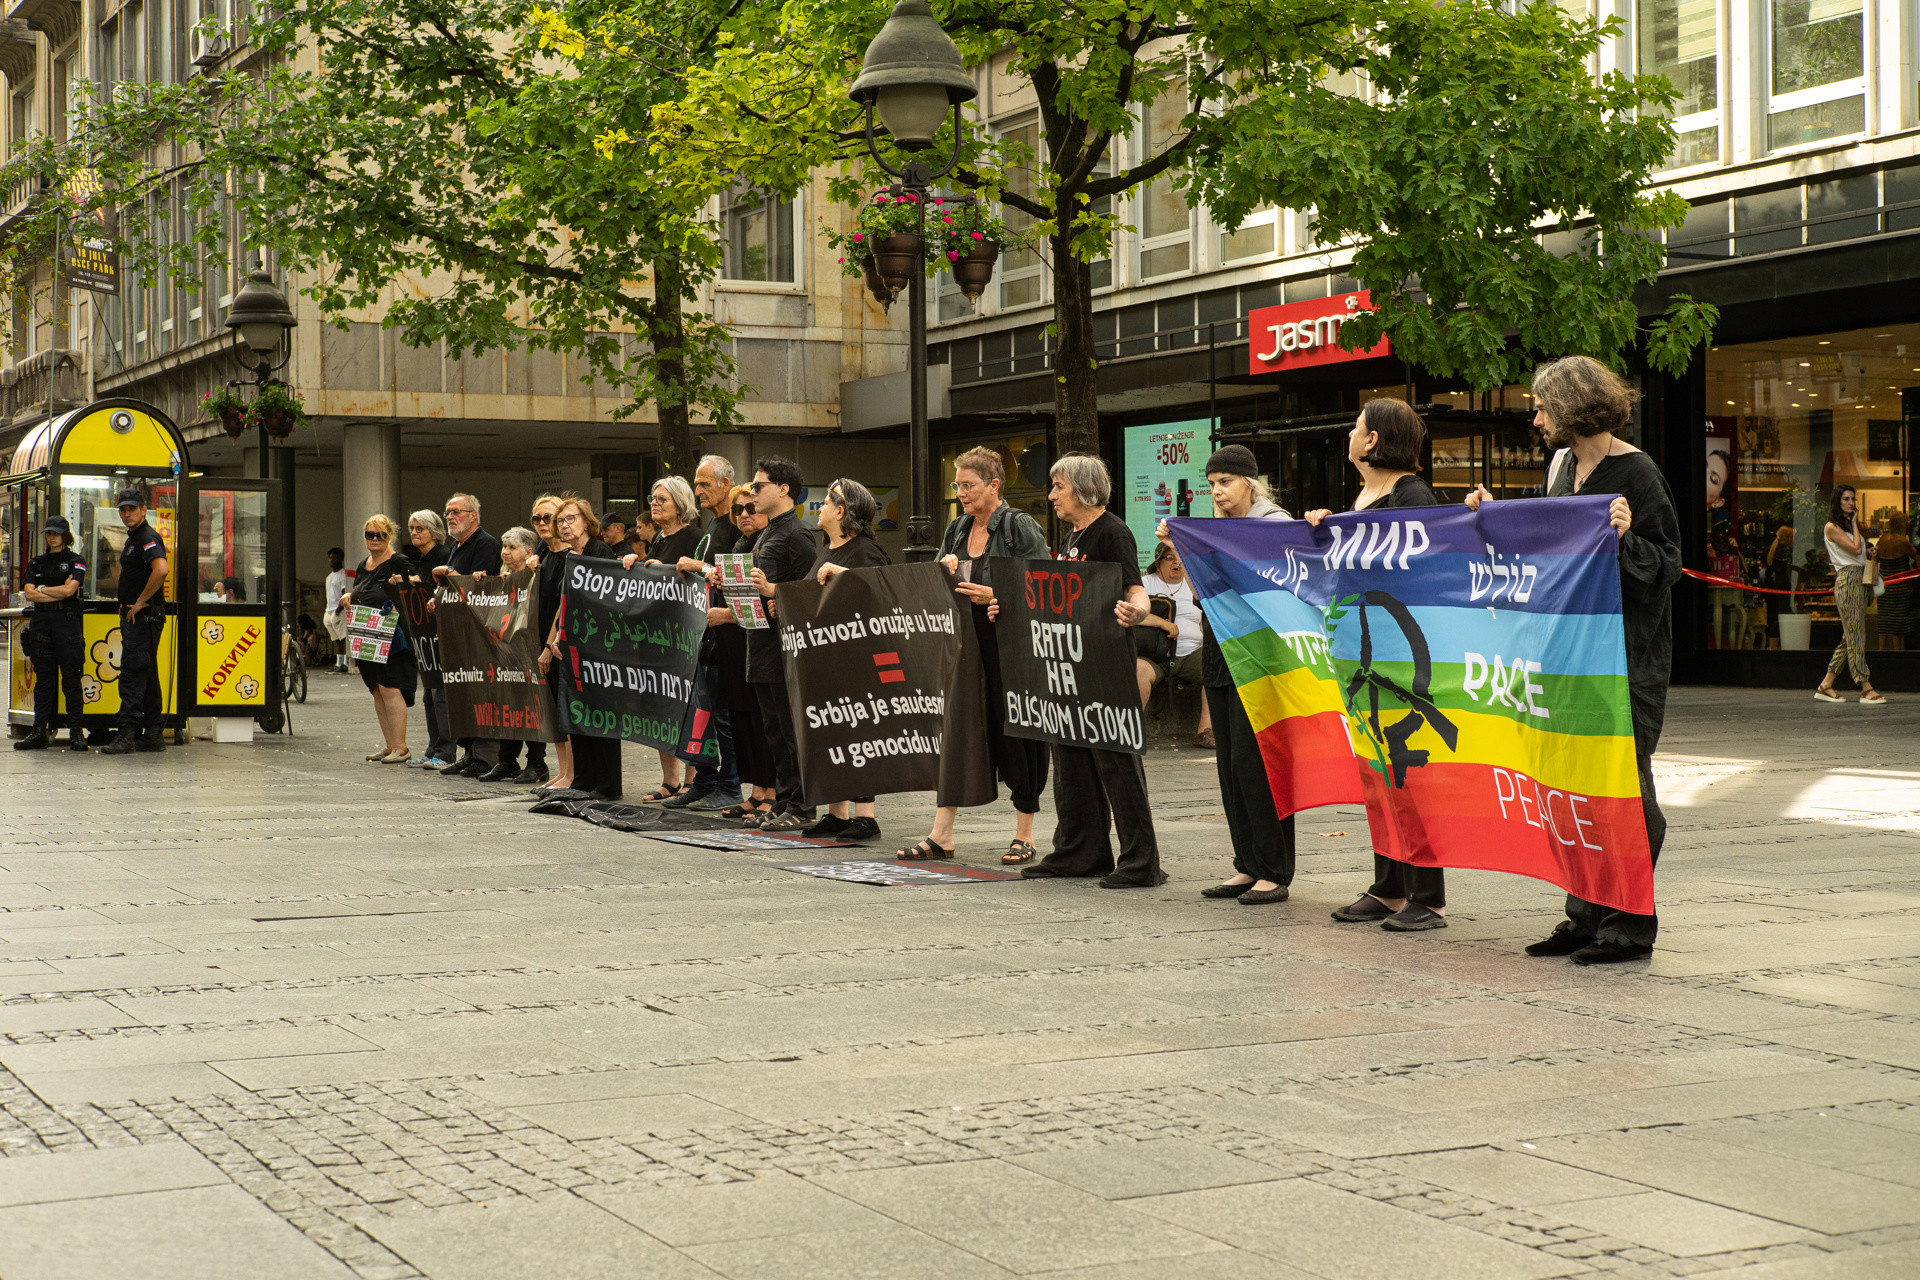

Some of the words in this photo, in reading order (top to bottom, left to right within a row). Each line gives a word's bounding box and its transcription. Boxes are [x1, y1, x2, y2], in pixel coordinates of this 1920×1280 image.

[78, 248, 86, 258] 18
[89, 250, 107, 263] JULY
[93, 261, 115, 275] PARK
[1257, 295, 1375, 361] Jasm
[1324, 521, 1430, 571] МИР
[571, 565, 614, 600] Stop
[615, 575, 684, 603] genocidu
[686, 585, 692, 606] u
[1025, 570, 1083, 619] STOP
[806, 612, 868, 647] izvozi
[868, 607, 915, 640] oružje
[914, 614, 926, 633] u
[1031, 619, 1083, 663] RATU
[202, 624, 262, 699] КОКИЦЕ
[442, 666, 484, 684] uschwitz
[625, 666, 657, 694] העם
[1046, 659, 1078, 696] NA
[1463, 651, 1550, 719] PACE
[474, 703, 493, 727] Will
[502, 704, 524, 728] Ever
[569, 700, 617, 735] Stop
[805, 696, 870, 729] Srbija
[867, 692, 890, 725] je
[890, 688, 945, 716] saučesni
[828, 746, 846, 765] u
[848, 728, 932, 768] genocidu
[1493, 767, 1603, 851] PEACE
